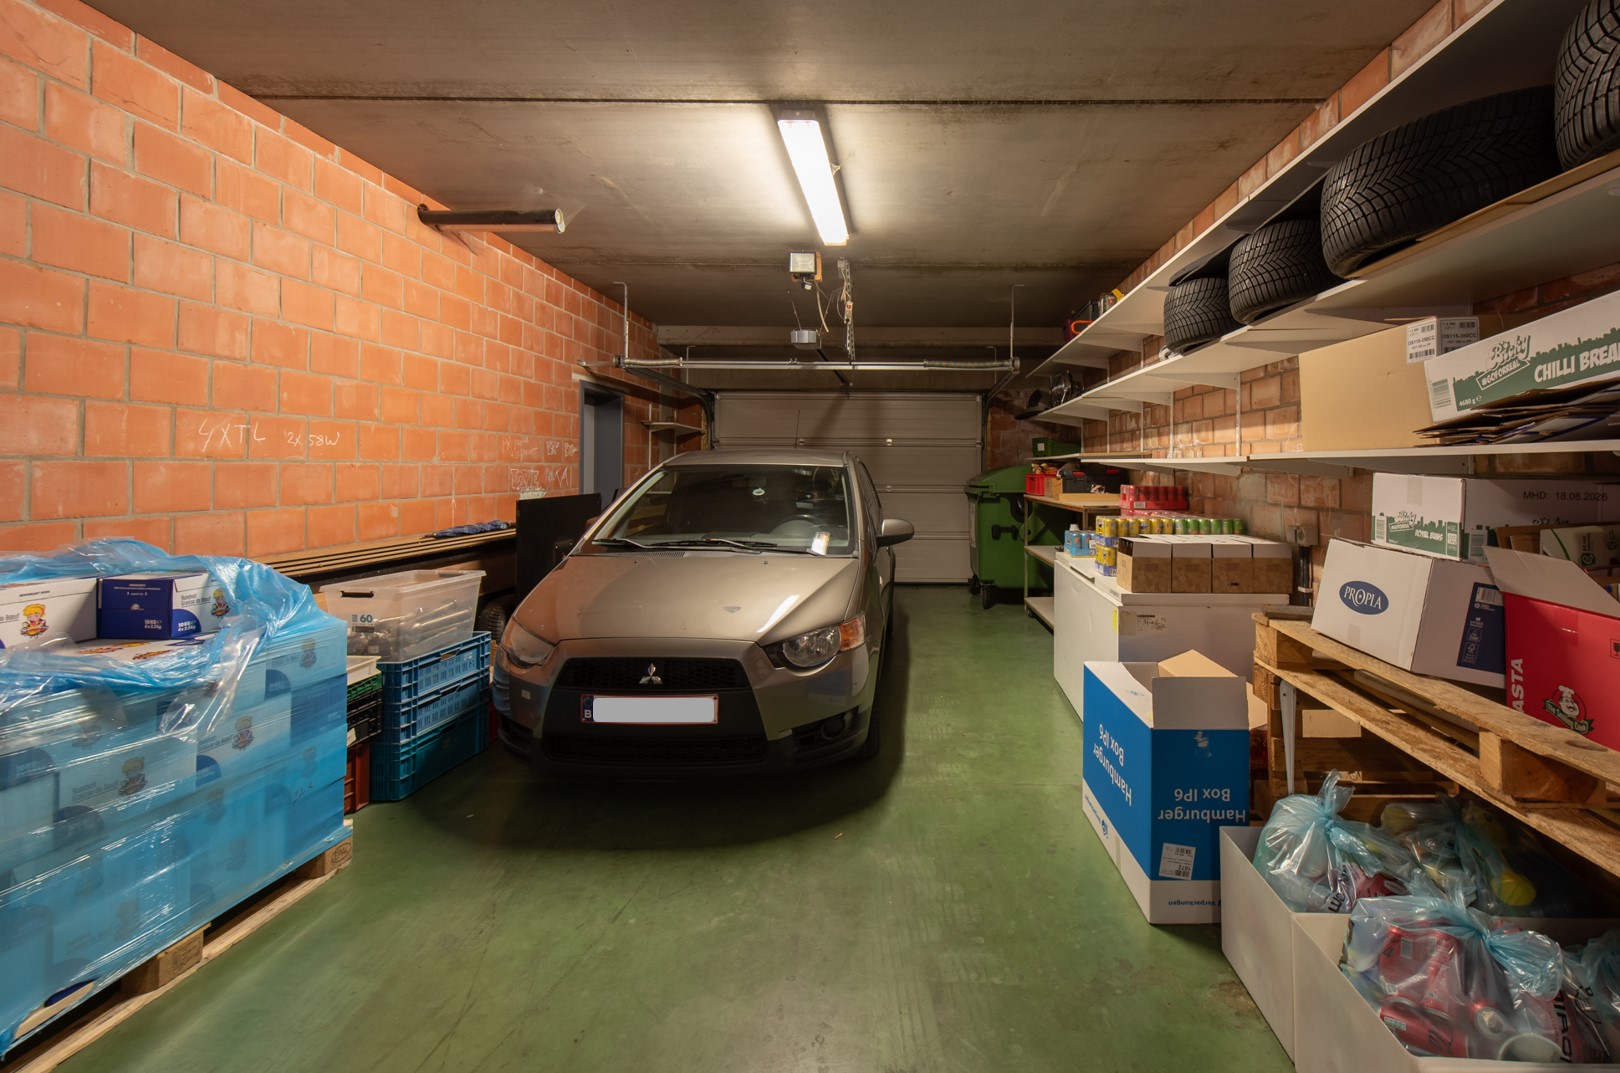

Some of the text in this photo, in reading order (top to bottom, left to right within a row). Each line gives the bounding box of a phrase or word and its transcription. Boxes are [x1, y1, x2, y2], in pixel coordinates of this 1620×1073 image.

[1534, 342, 1620, 382] CHILLI BREA
[1523, 491, 1549, 500] MHD:
[1343, 586, 1382, 610] PROPIA
[360, 614, 372, 623] 60
[1510, 658, 1524, 714] ASTA
[584, 709, 592, 718] B
[1098, 723, 1124, 767] Box IP6
[1093, 743, 1132, 807] Hamburger
[1174, 788, 1231, 802] Box IP6
[1158, 807, 1246, 823] Hamburger
[1168, 899, 1216, 907] Verpackungen
